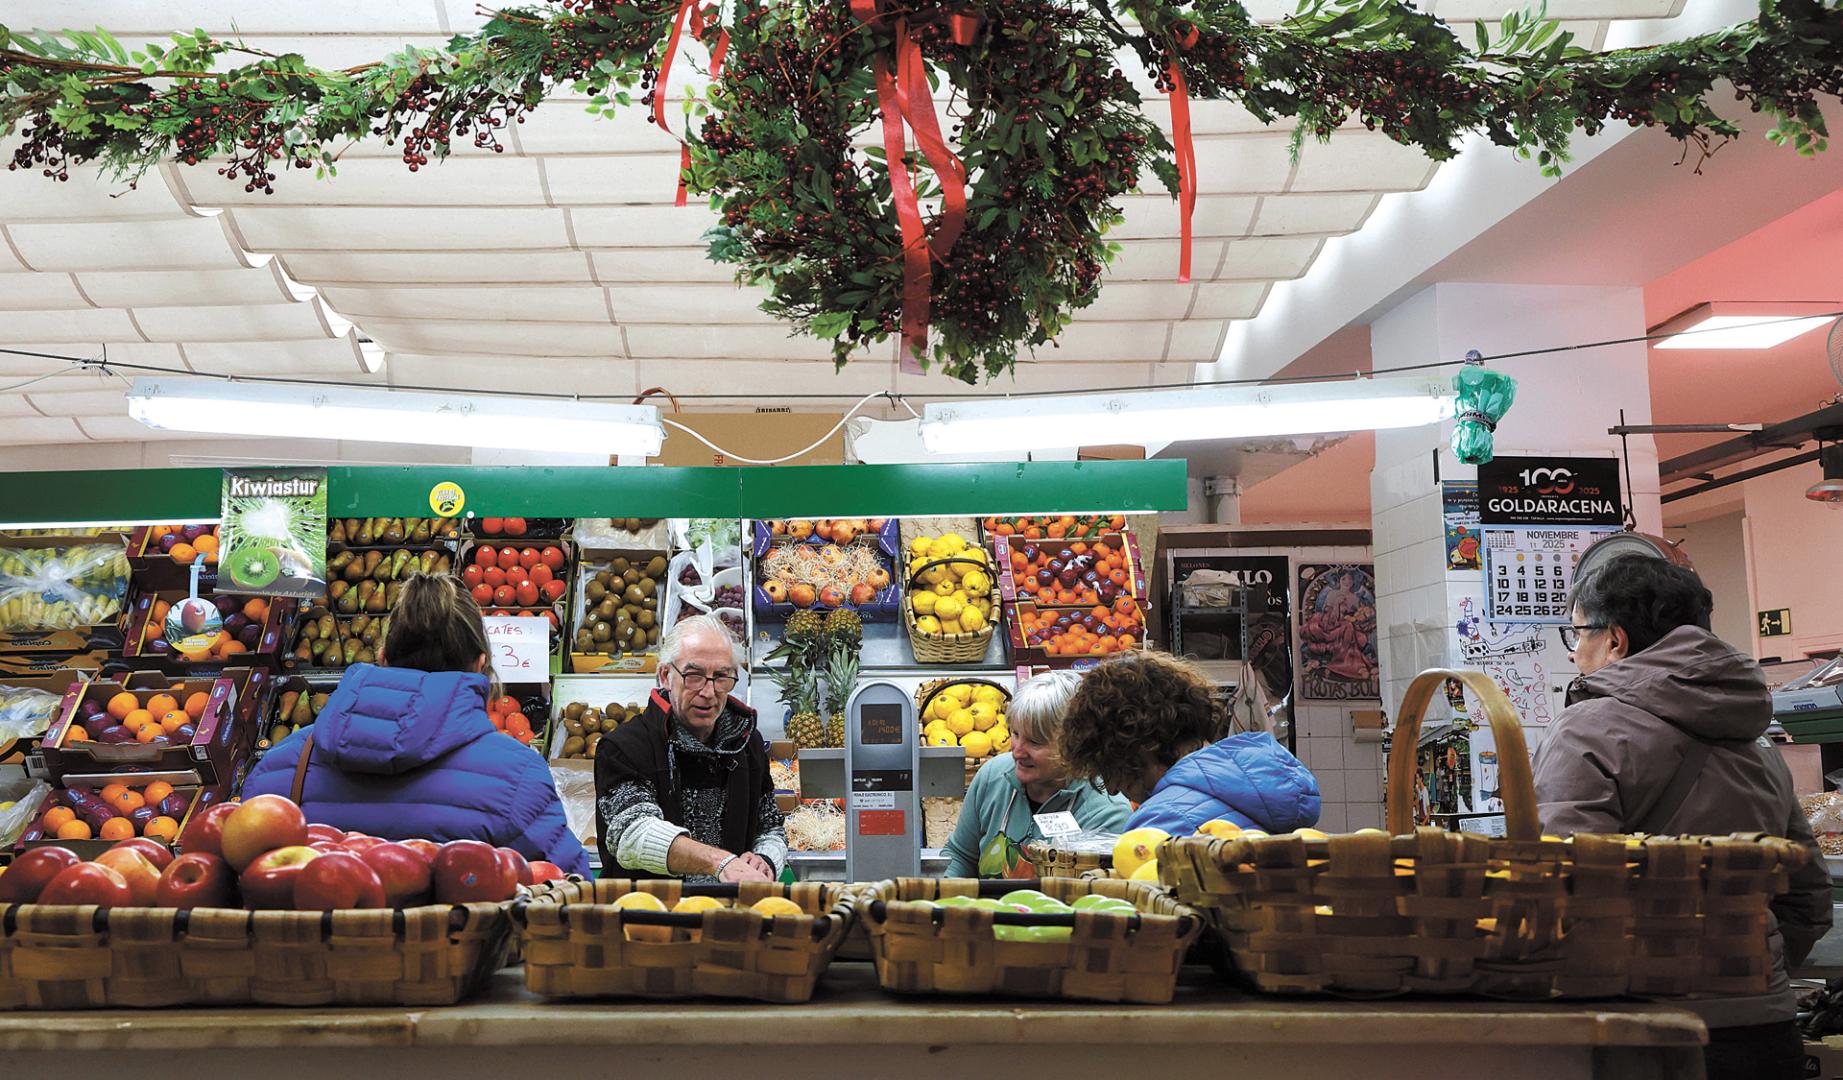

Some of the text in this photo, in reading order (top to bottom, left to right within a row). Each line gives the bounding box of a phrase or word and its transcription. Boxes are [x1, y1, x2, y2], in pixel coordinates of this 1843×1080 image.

[230, 477, 318, 497] Kiwiastur
[1488, 499, 1615, 514] GOLDARACENA
[1527, 531, 1579, 540] NOVIEMBRE
[1542, 540, 1565, 548] 2025
[1498, 566, 1562, 575] 3 4 5 6
[1497, 579, 1565, 589] 10 11 12 13
[1497, 592, 1510, 602] 17
[1516, 592, 1528, 602] 18
[1535, 592, 1547, 602] 19
[1496, 605, 1568, 616] 24 25 26 27
